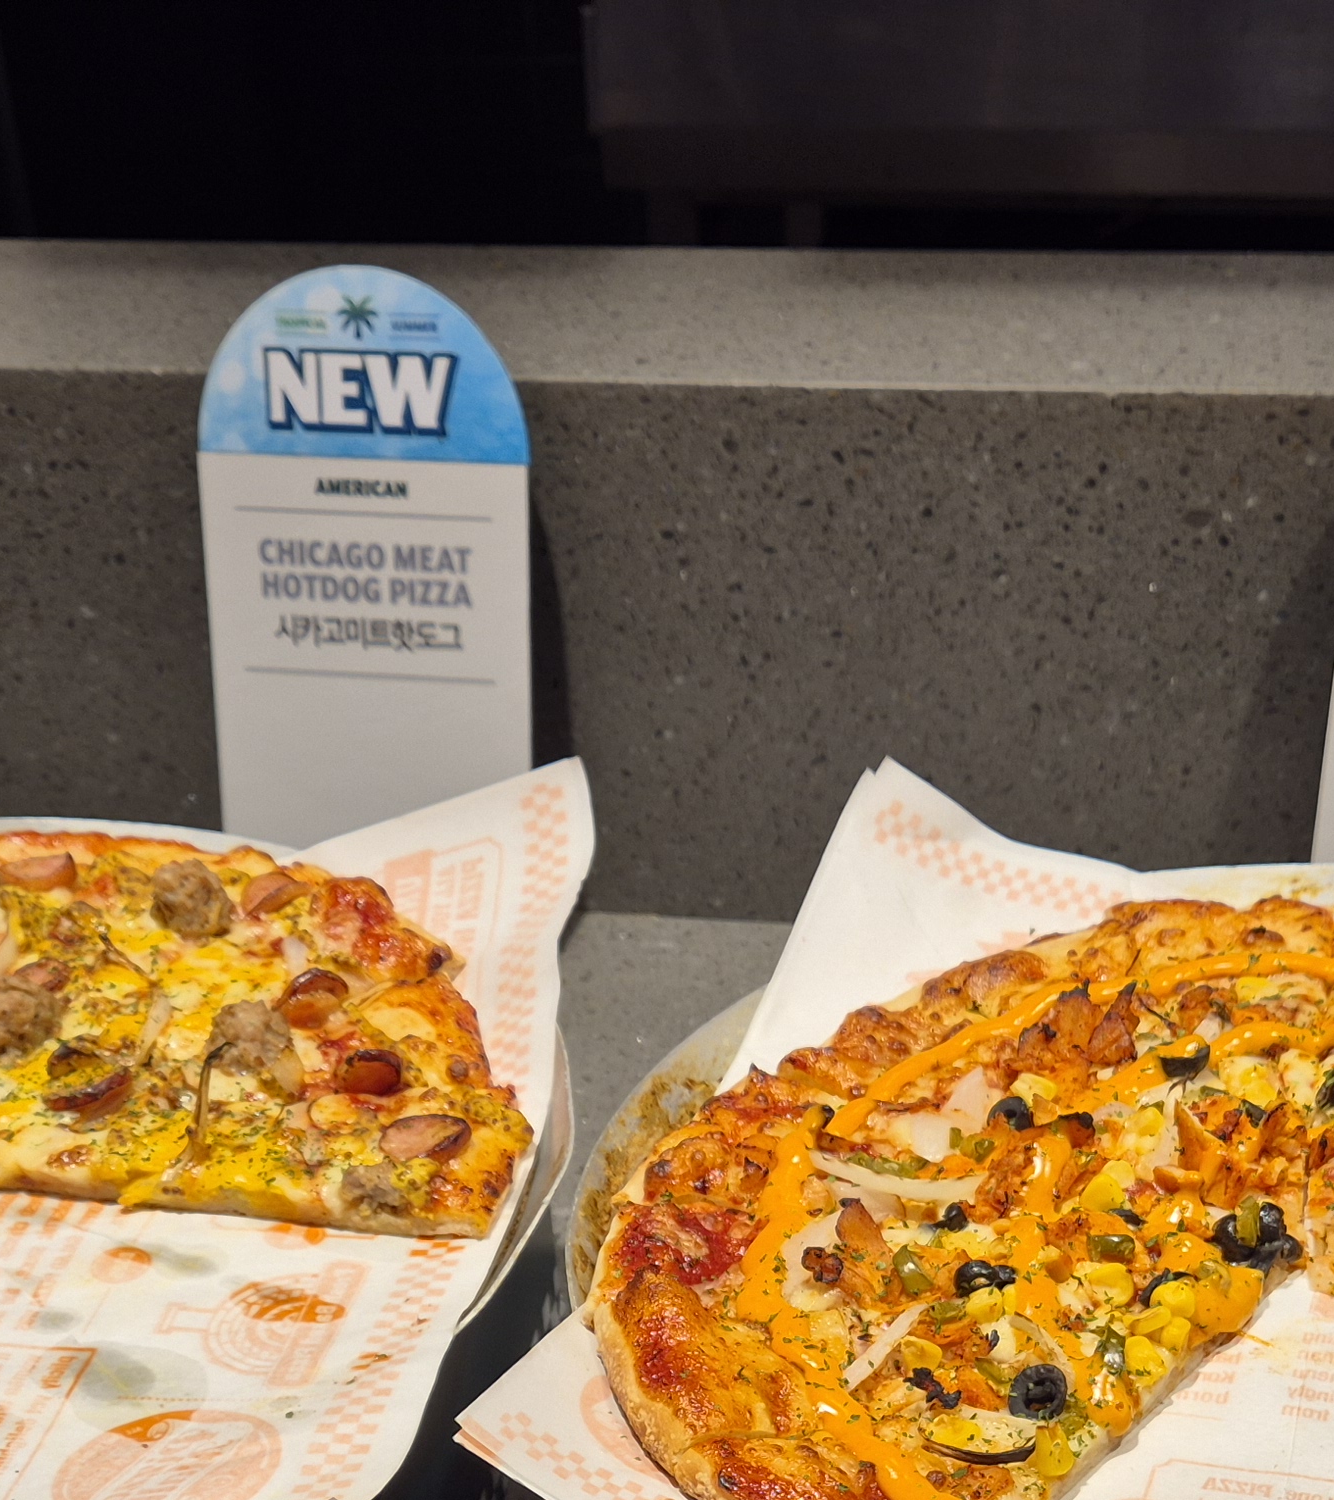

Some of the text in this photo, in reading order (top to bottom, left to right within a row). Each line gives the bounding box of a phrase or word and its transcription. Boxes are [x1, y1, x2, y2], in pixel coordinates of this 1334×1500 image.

[263, 348, 457, 437] NEW
[315, 478, 408, 499] AMERICAN
[258, 539, 472, 574] CHICAGO MEAT
[261, 570, 472, 608] HOTDOG PIZZA
[275, 614, 463, 650] 시카고미트핫도그
